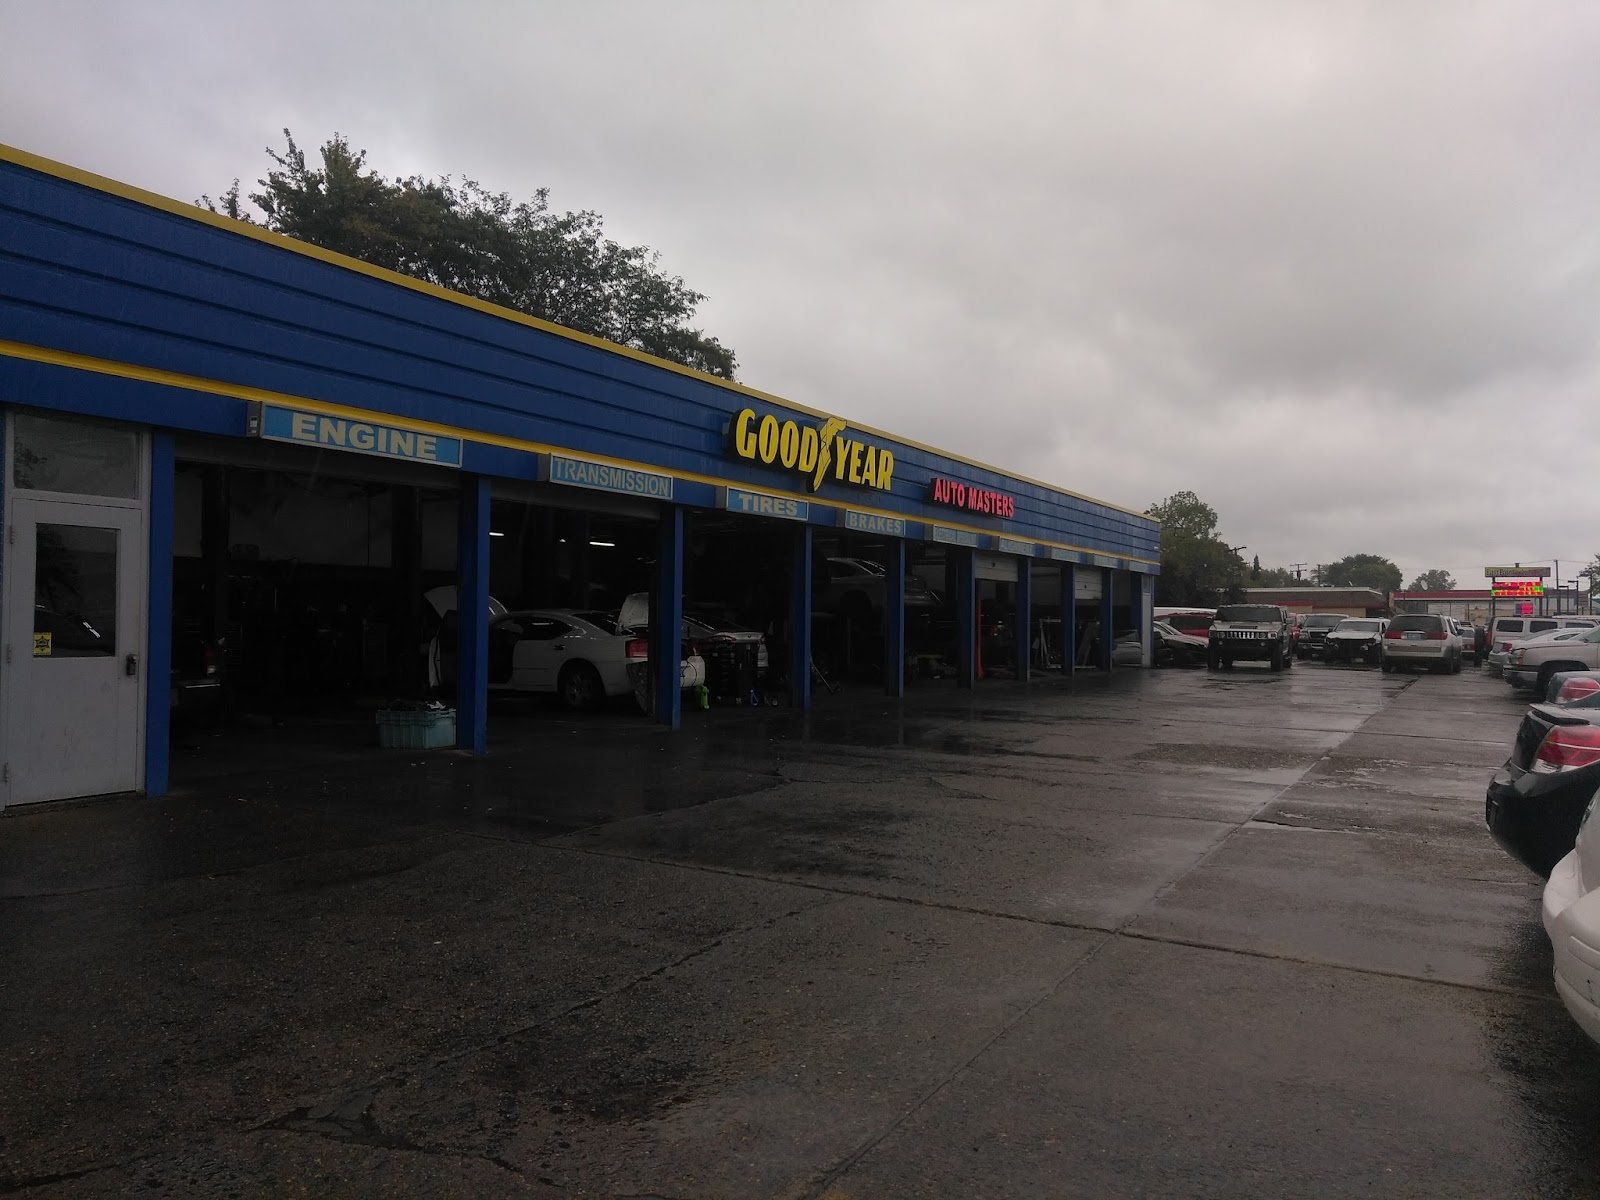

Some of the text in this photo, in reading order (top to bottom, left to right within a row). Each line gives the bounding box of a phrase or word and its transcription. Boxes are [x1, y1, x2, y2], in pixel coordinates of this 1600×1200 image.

[291, 412, 437, 461] ENGINE
[554, 458, 669, 497] TRANSMISSION
[738, 493, 798, 516] TIRES
[934, 478, 1015, 517] AUTO MASTERS
[849, 512, 902, 534] BRAKES
